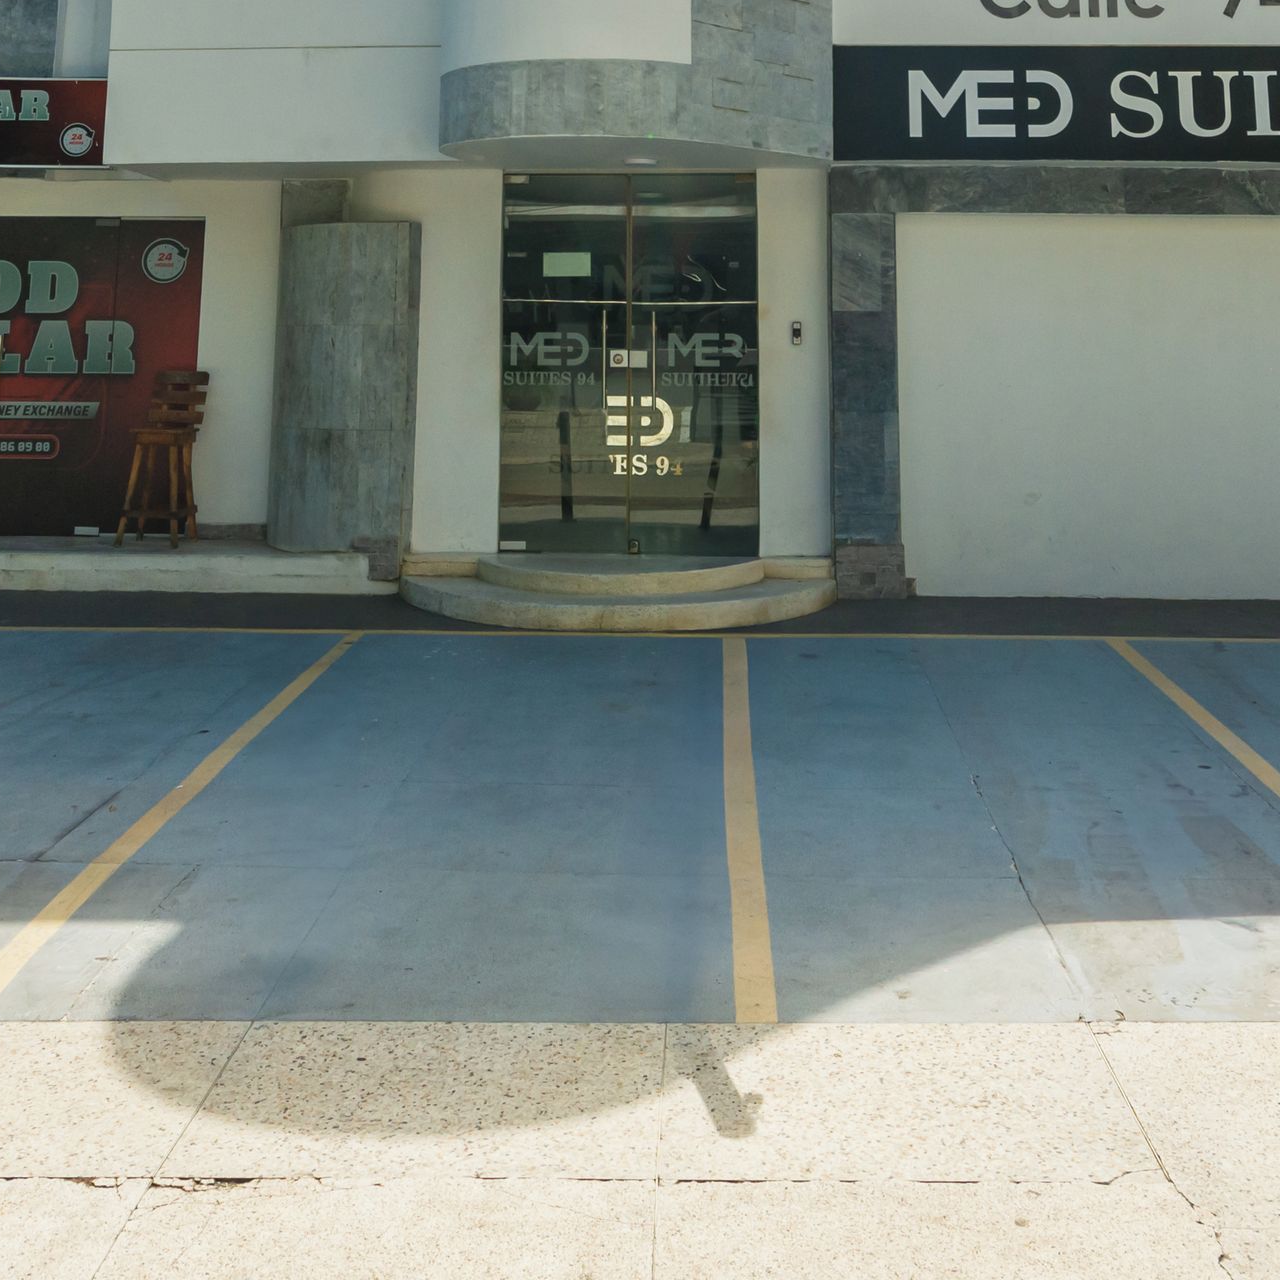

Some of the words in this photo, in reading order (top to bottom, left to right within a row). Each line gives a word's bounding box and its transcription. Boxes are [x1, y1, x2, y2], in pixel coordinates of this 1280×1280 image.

[907, 69, 1073, 138] MED
[510, 332, 590, 367] MED
[503, 371, 572, 386] SUITES
[577, 372, 596, 386] 94
[22, 405, 90, 417] EXCHANGE
